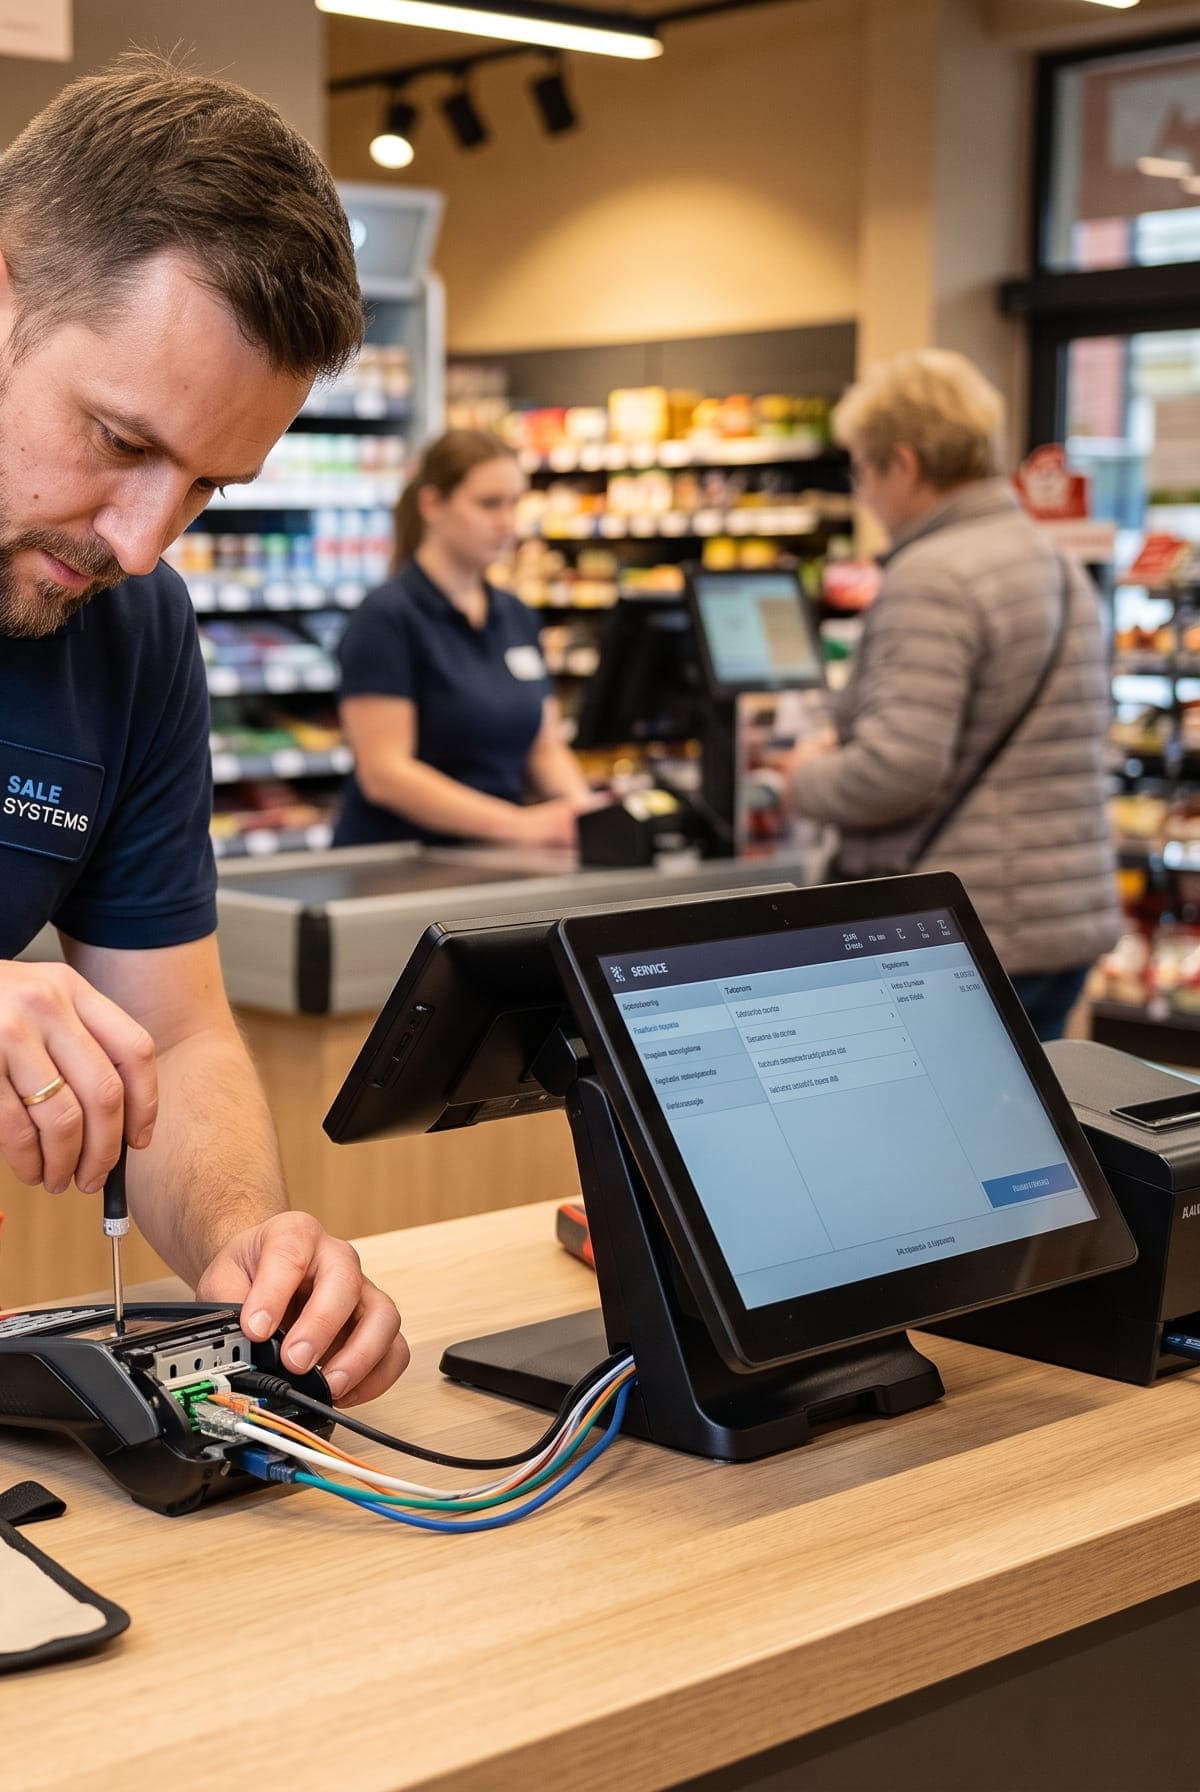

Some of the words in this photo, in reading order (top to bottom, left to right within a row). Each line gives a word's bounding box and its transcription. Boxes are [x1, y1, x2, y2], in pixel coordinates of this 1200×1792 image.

[7, 775, 63, 805] SALE
[2, 797, 89, 832] SYSTEMS
[630, 962, 669, 978] SERVICE
